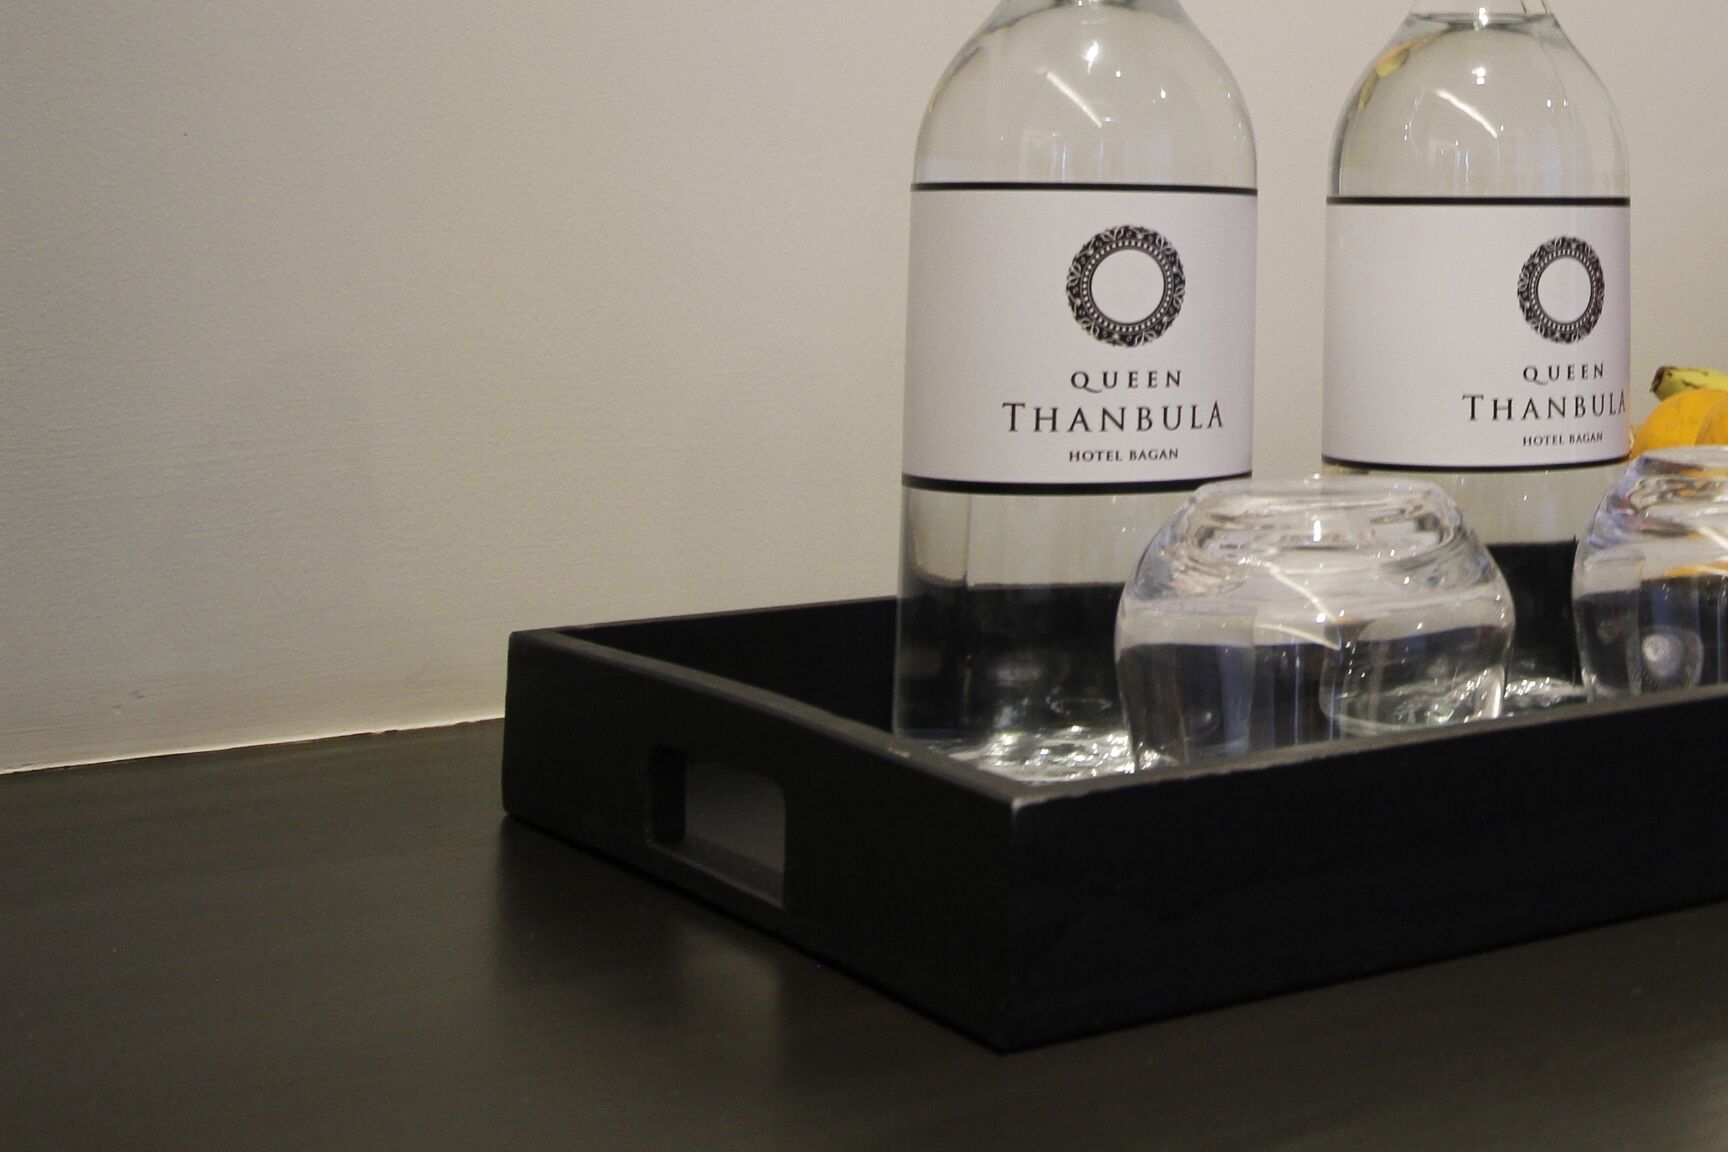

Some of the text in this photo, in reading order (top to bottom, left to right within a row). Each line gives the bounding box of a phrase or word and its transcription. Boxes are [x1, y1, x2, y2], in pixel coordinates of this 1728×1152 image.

[1070, 369, 1182, 393] QUEEN
[1522, 362, 1605, 385] QUEEN
[1001, 400, 1224, 433] THANBULA
[1462, 389, 1626, 422] THANBULA
[1522, 431, 1603, 447] HOTEL BAGAN
[1068, 448, 1179, 463] HOTEL BAGAN
